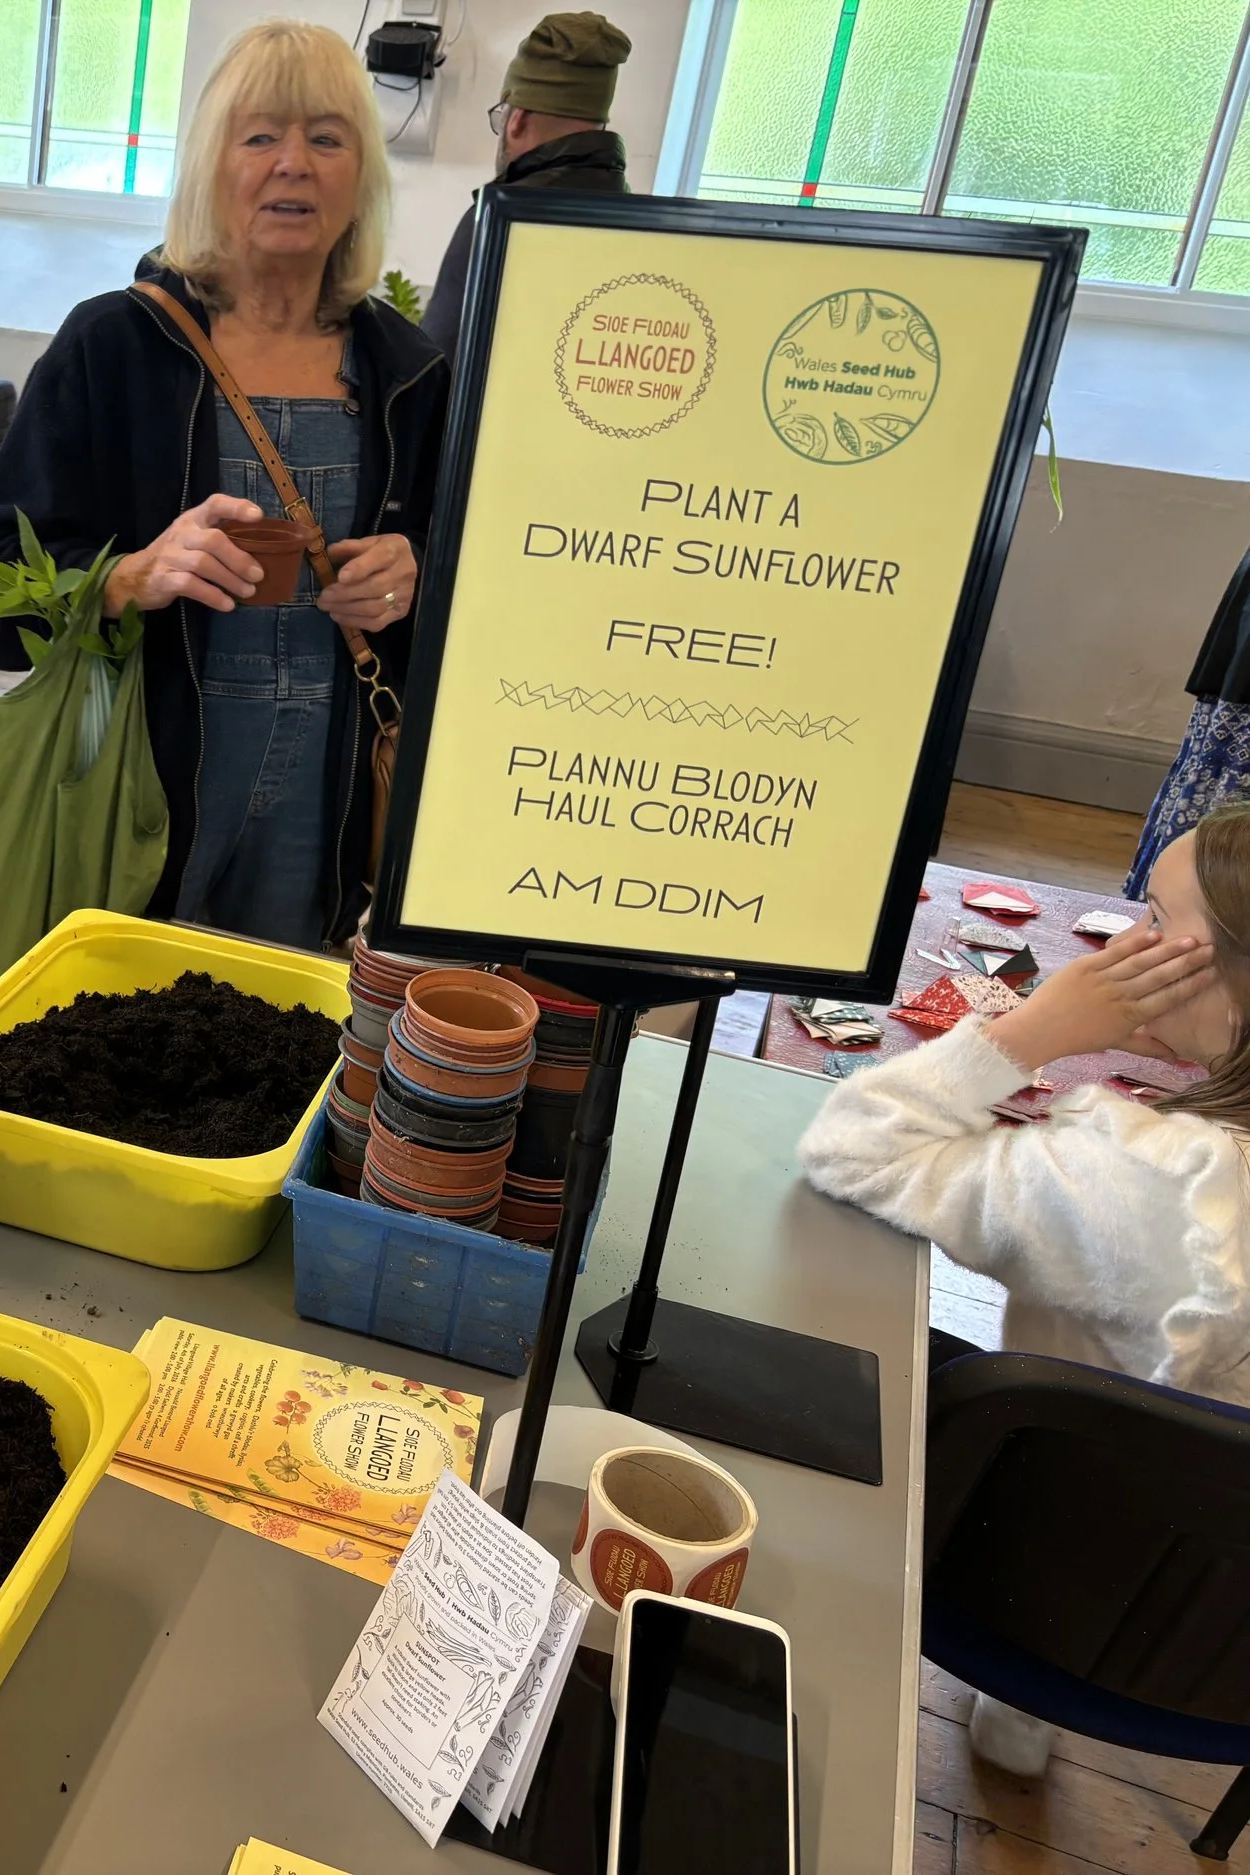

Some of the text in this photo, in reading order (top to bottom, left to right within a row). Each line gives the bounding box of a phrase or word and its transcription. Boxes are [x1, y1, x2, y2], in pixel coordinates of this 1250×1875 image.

[592, 314, 690, 340] SIOE FLODAU
[575, 338, 696, 375] LLANGOED
[794, 357, 916, 380] Wales Seed Hub
[576, 375, 683, 401] FLOWER SHOW
[784, 376, 928, 402] Hwb Hadau Cymru
[641, 478, 801, 528] PLANT A
[523, 523, 900, 595] DWARF SUNFLOWER
[606, 620, 777, 669] FREE!
[507, 746, 818, 811] PLANNU BLODYN
[514, 787, 794, 848] HAUL CORRACH
[508, 866, 764, 924] AM DDIM
[180, 1376, 188, 1385] Hall
[183, 1362, 193, 1375] Village
[234, 1363, 243, 1381] created
[252, 1365, 264, 1389] vegetables,
[263, 1360, 278, 1385] Celebrating
[176, 1345, 219, 1451] www.llangoedflowershow.com
[226, 1388, 235, 1405] makers
[236, 1394, 244, 1408] crafts
[209, 1409, 218, 1418] bob
[345, 1412, 370, 1470] FLOWER SHOW
[367, 1415, 400, 1480] LLANGOED
[397, 1428, 420, 1482] SIOE FLODAU
[498, 1537, 510, 1549] from
[501, 1529, 518, 1544] before
[517, 1542, 526, 1550] off
[474, 1549, 488, 1562] direct
[482, 1546, 492, 1556] Sow
[498, 1548, 520, 1567] seedlings
[482, 1567, 500, 1582] started
[507, 1576, 519, 1588] frost
[512, 1569, 520, 1579] has
[520, 1566, 545, 1589] Transplant
[614, 1548, 636, 1599] LLANGOED
[716, 1564, 734, 1606] LANGOED
[508, 1587, 518, 1595] can
[519, 1594, 534, 1608] Seeds
[520, 1585, 536, 1600] spring
[424, 1572, 513, 1652] Seed Hub Hwb Hadau Cymru
[441, 1607, 451, 1618] and
[450, 1616, 471, 1634] packed
[405, 1641, 446, 1681] Dwarf Sunflower
[416, 1641, 440, 1665] SUNSPOT
[408, 1684, 417, 1693] and
[423, 1696, 433, 1706] only
[438, 1706, 447, 1717] feet
[440, 1691, 450, 1701] with
[406, 1700, 414, 1708] for
[414, 1706, 431, 1723] borders
[401, 1720, 413, 1734] seeds
[352, 1709, 422, 1788] www.seedhub.wales
